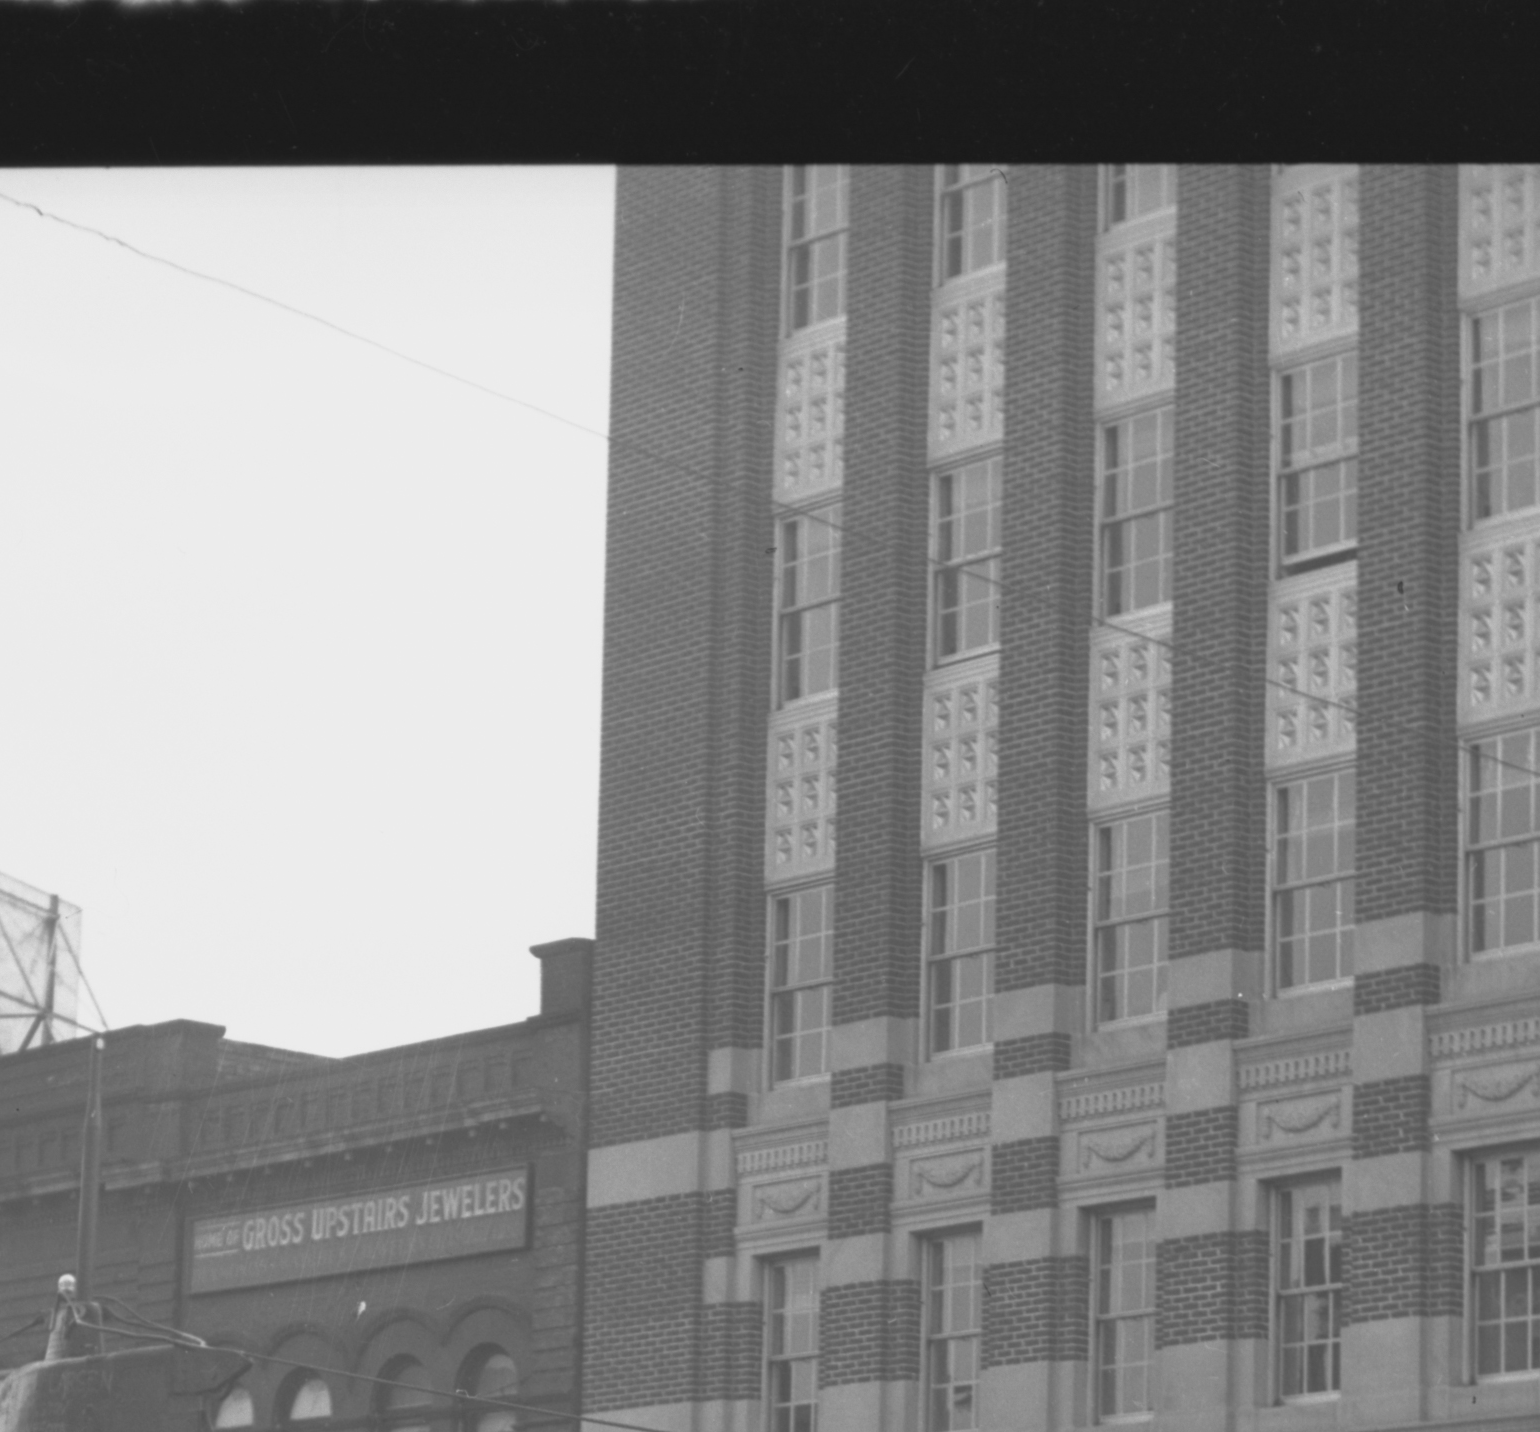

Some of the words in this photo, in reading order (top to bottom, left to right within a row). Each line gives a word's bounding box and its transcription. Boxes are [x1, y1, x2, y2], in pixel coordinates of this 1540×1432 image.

[242, 1210, 305, 1252] GROSS
[310, 1194, 410, 1241] UPSTAIRS
[414, 1176, 526, 1226] JEWELERS
